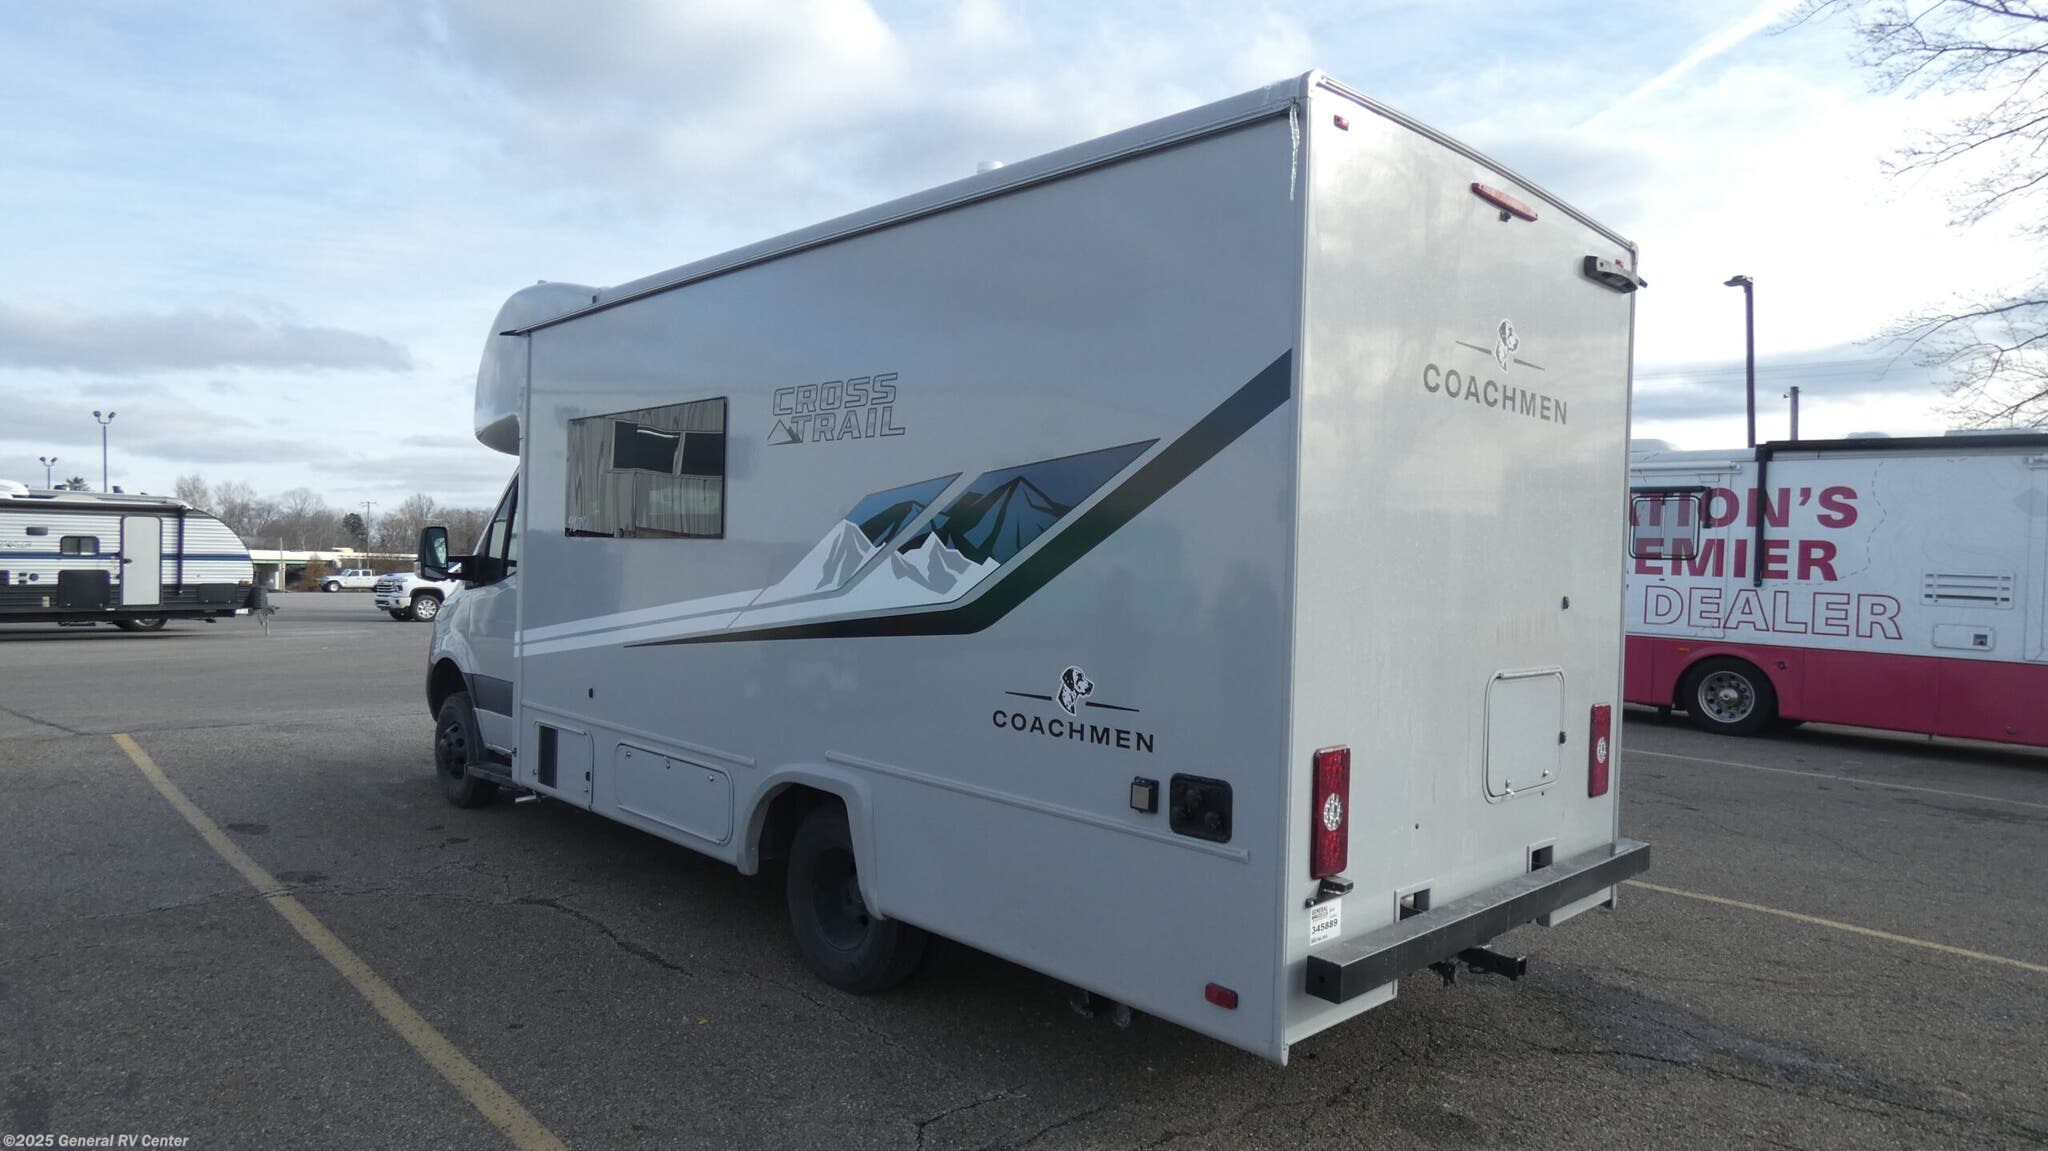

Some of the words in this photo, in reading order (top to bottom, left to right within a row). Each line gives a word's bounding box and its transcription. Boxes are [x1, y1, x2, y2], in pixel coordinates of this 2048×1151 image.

[772, 372, 898, 416] CROSS
[1423, 363, 1567, 424] COACHMEN
[791, 406, 906, 443] TRAIL
[1643, 585, 1903, 640] DEALER
[992, 710, 1154, 753] COACHMEN
[1311, 918, 1338, 934] 345889
